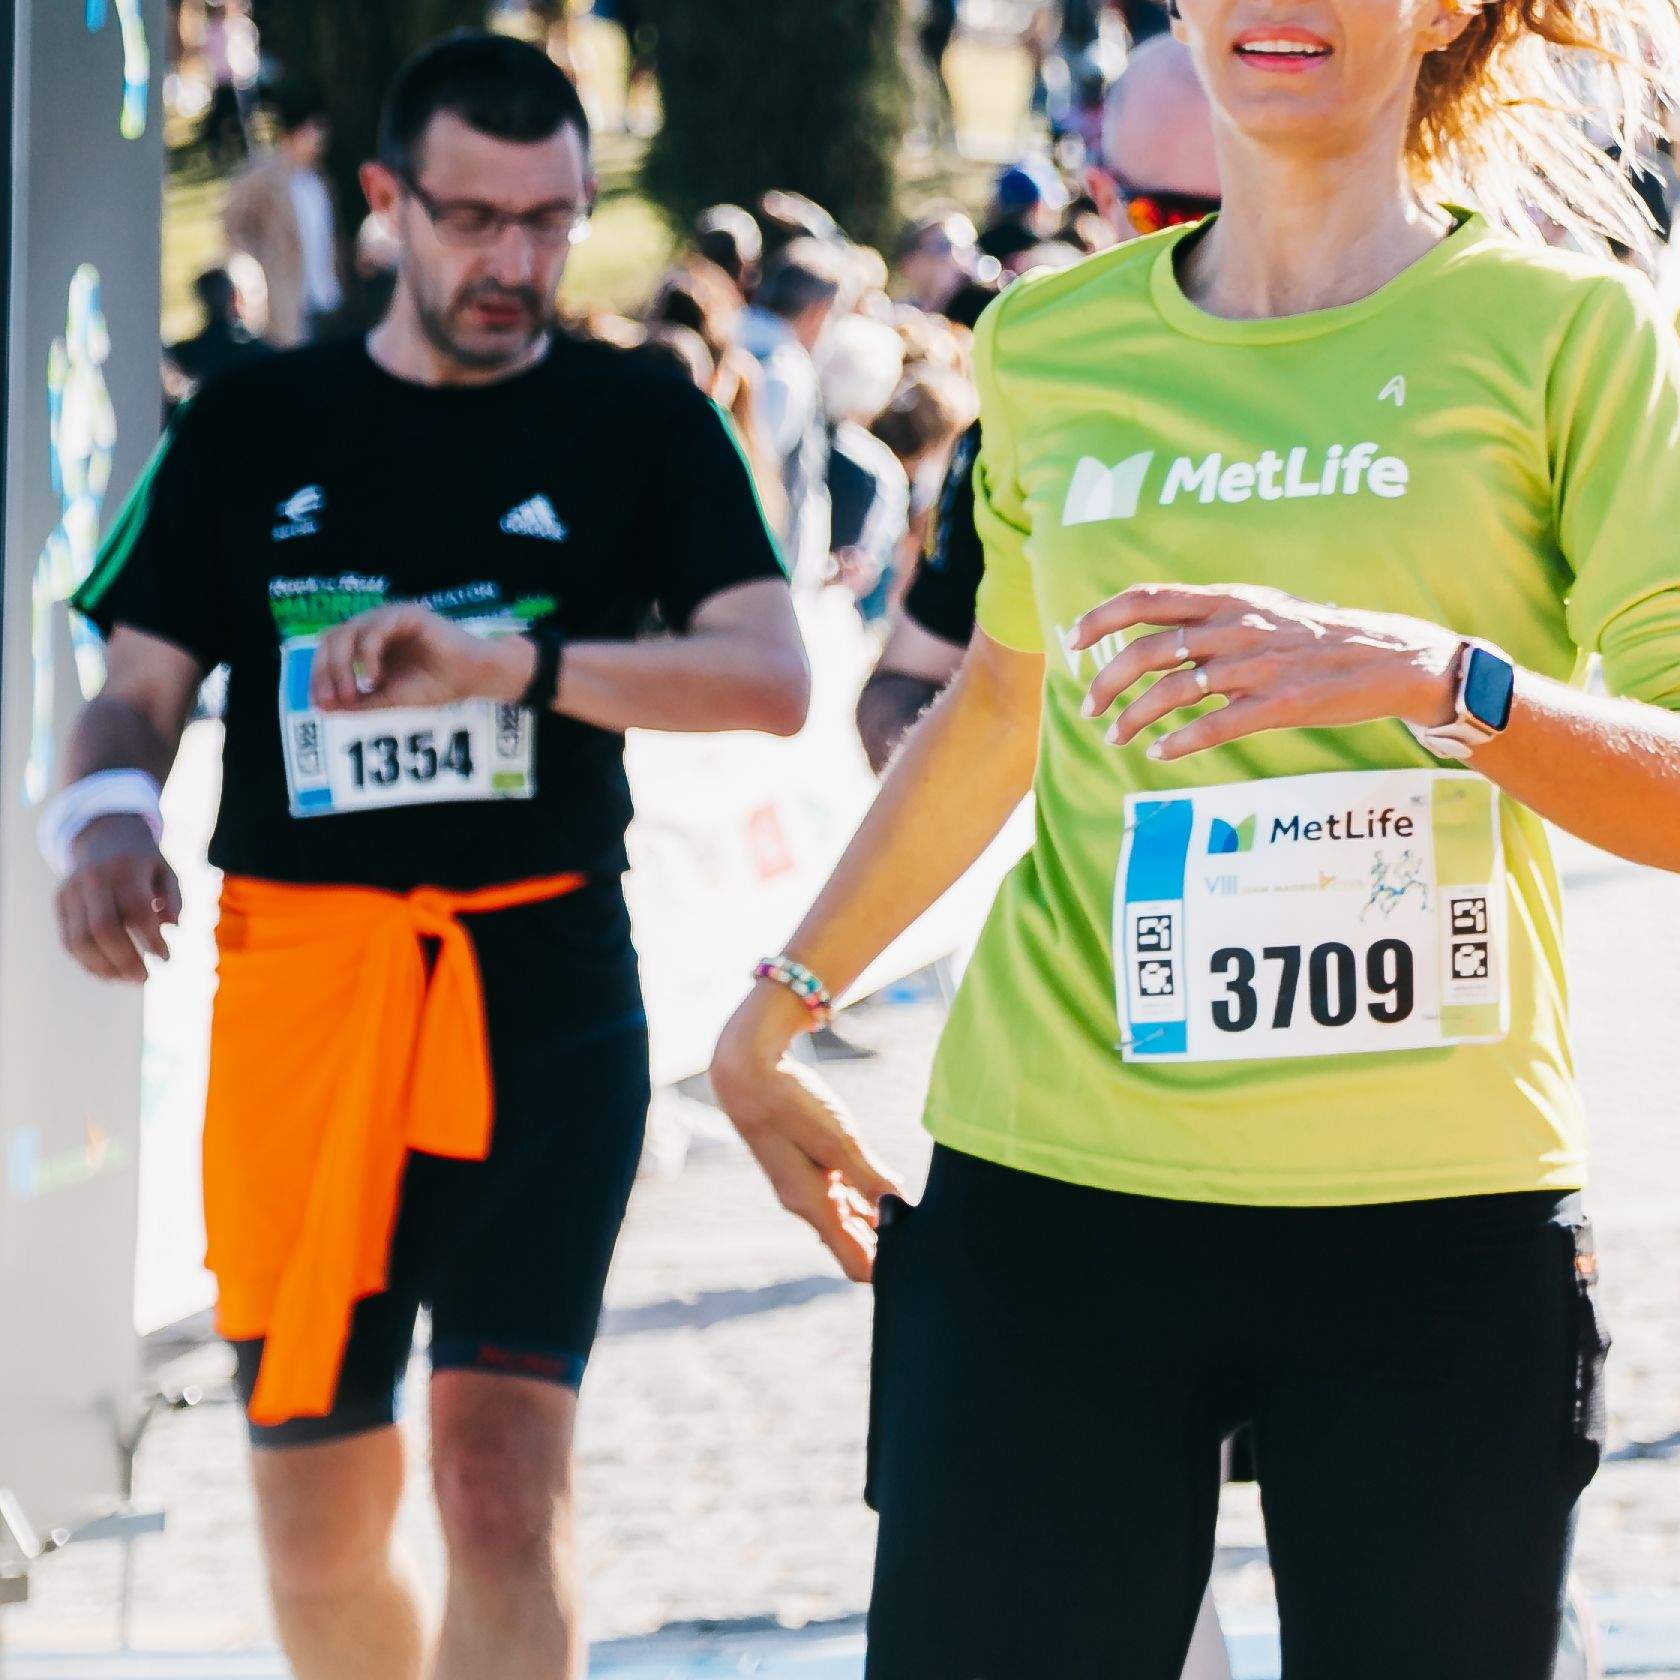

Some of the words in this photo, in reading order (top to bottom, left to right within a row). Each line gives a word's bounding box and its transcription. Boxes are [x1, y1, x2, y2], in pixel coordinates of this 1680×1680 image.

[1157, 441, 1410, 506] MetLife
[345, 727, 474, 789] 1354
[1270, 807, 1415, 844] MetLife
[1208, 937, 1415, 1033] 3709
